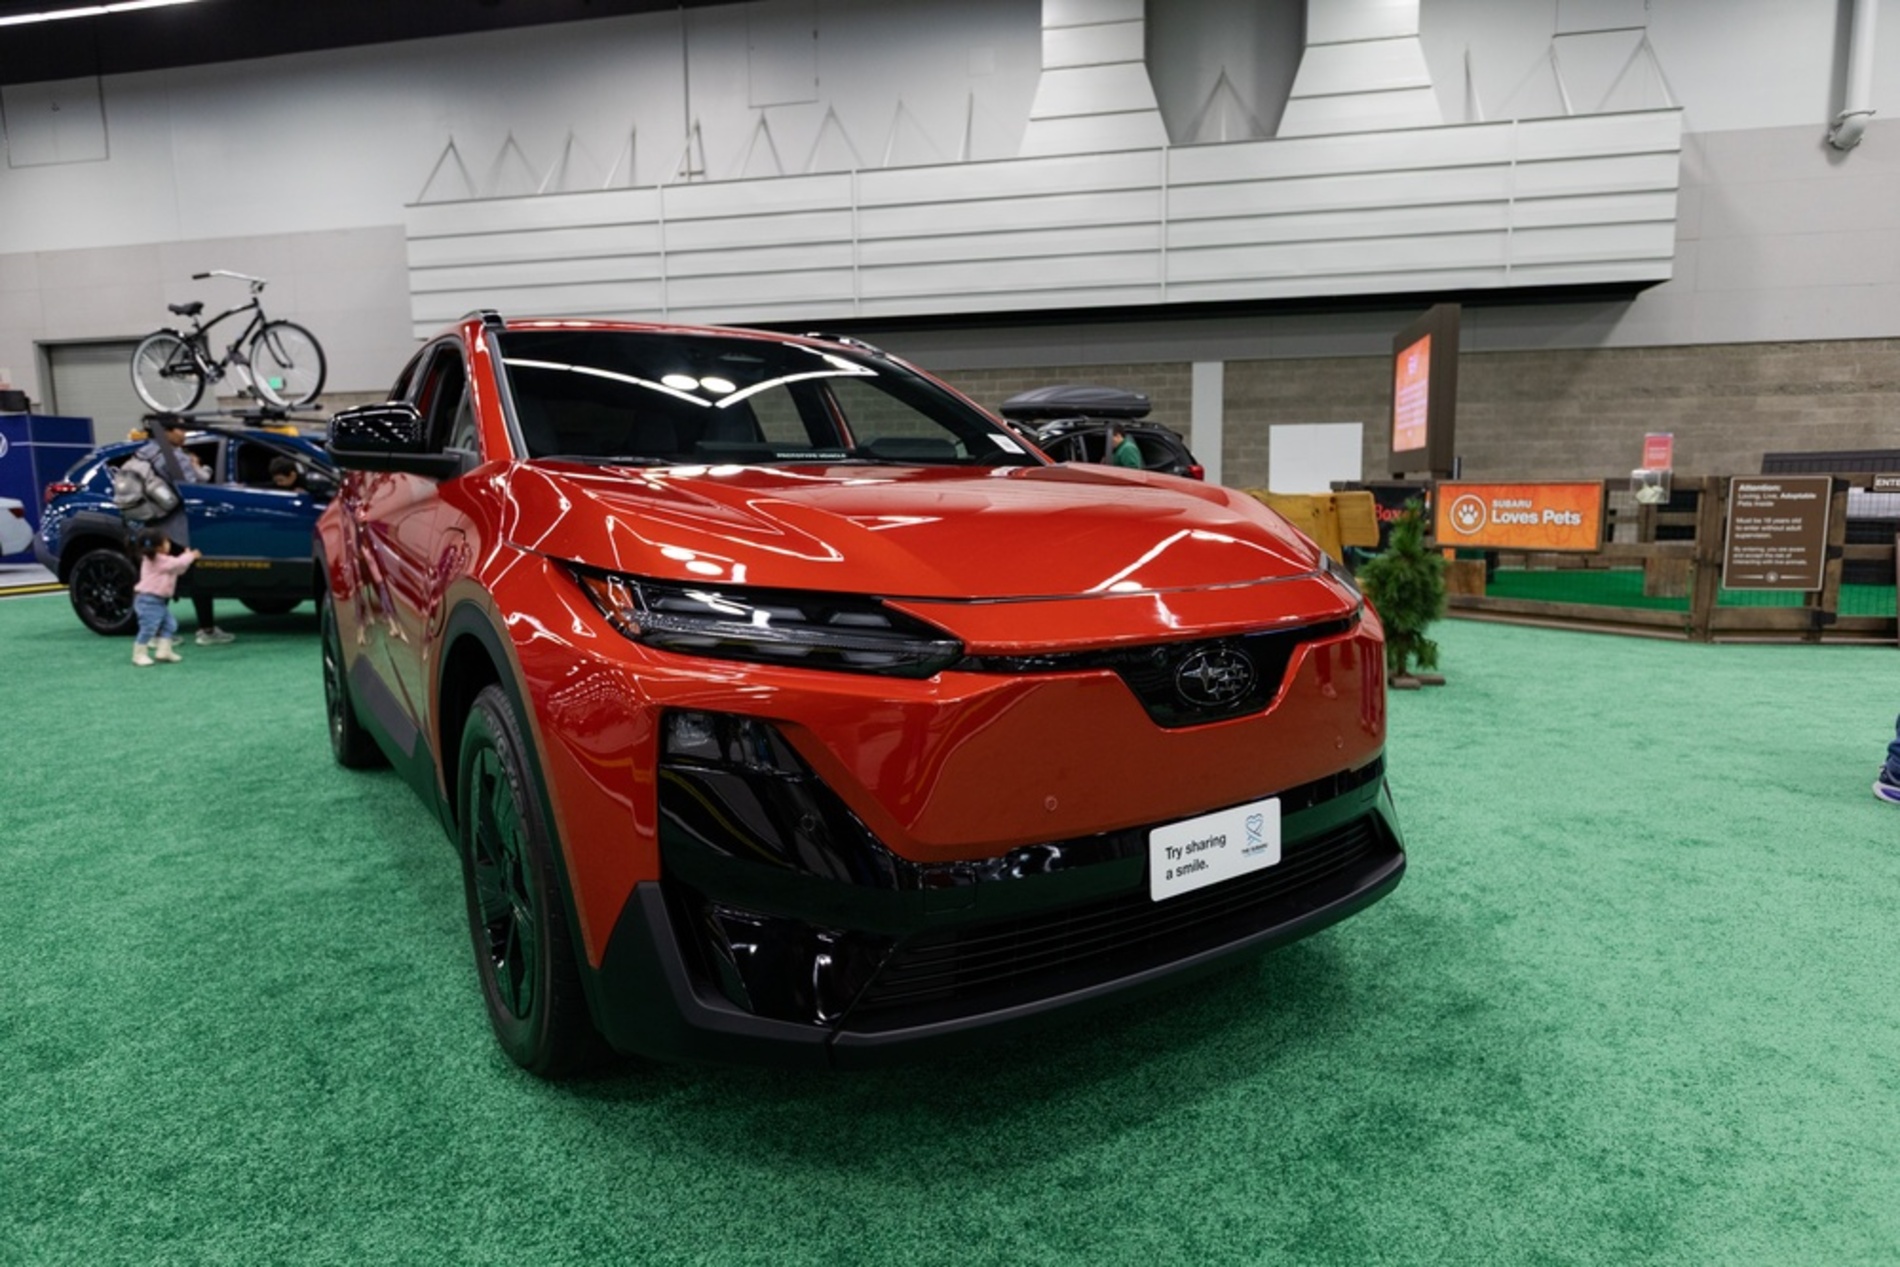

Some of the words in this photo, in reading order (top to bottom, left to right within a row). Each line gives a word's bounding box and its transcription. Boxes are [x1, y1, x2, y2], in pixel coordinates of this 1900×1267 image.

[1738, 484, 1781, 492] Attention:
[1780, 492, 1817, 500] Adoptable
[1492, 499, 1532, 508] SUBARU
[1491, 510, 1538, 524] Loves
[1542, 509, 1581, 525] Pets
[1165, 846, 1183, 860] Try
[1185, 834, 1227, 854] sharing
[1165, 869, 1173, 880] a
[1175, 859, 1209, 877] smile.
